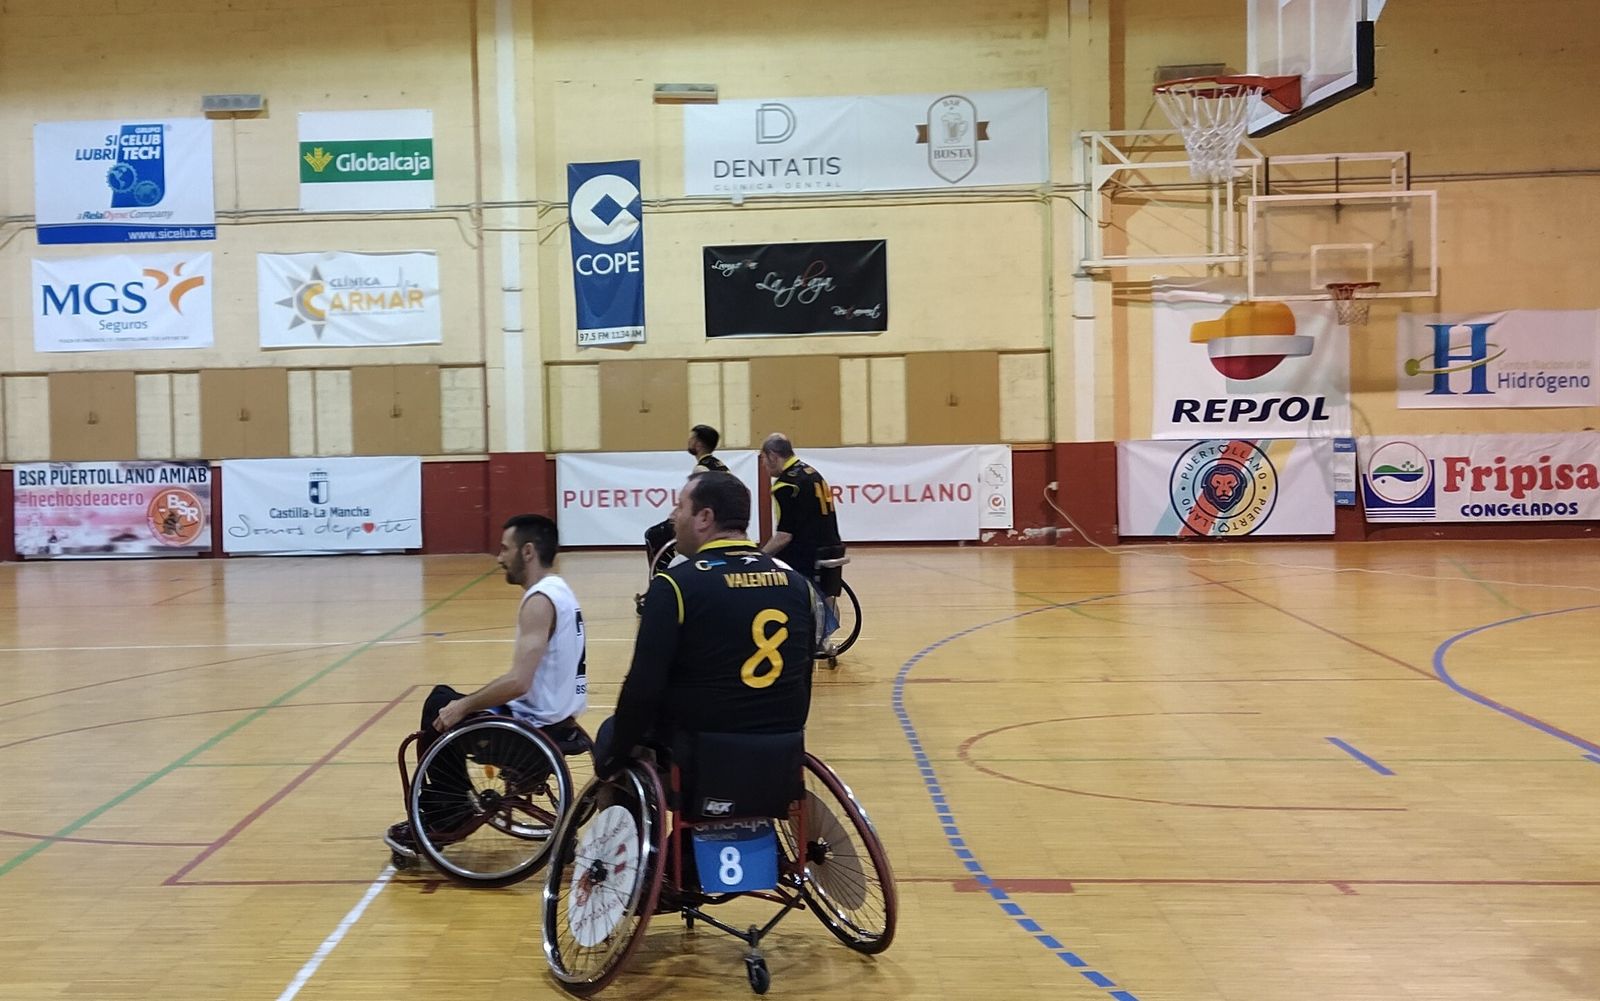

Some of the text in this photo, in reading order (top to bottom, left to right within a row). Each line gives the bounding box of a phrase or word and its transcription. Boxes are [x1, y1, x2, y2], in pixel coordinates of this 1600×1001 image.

[336, 151, 431, 176] Globalcaja
[933, 148, 973, 159] BUSTA
[714, 156, 841, 178] DENTATIS
[785, 181, 841, 189] DENTAL
[129, 209, 174, 220] Company
[128, 227, 214, 240] www.sicelub.es
[576, 251, 640, 276] COPE
[42, 281, 147, 315] MGS
[99, 319, 148, 333] Seguros
[1497, 371, 1591, 393] Hidrógeno
[1172, 396, 1330, 423] REPSOL
[19, 467, 207, 486] BSR PUERTOLLANO AMIAB
[1443, 455, 1600, 499] Fripisa
[269, 506, 371, 519] Castilla-La Mancha
[1461, 502, 1579, 518] CONGELADOS
[228, 514, 304, 538] Somos
[740, 608, 789, 689] 8
[719, 846, 744, 886] 8
